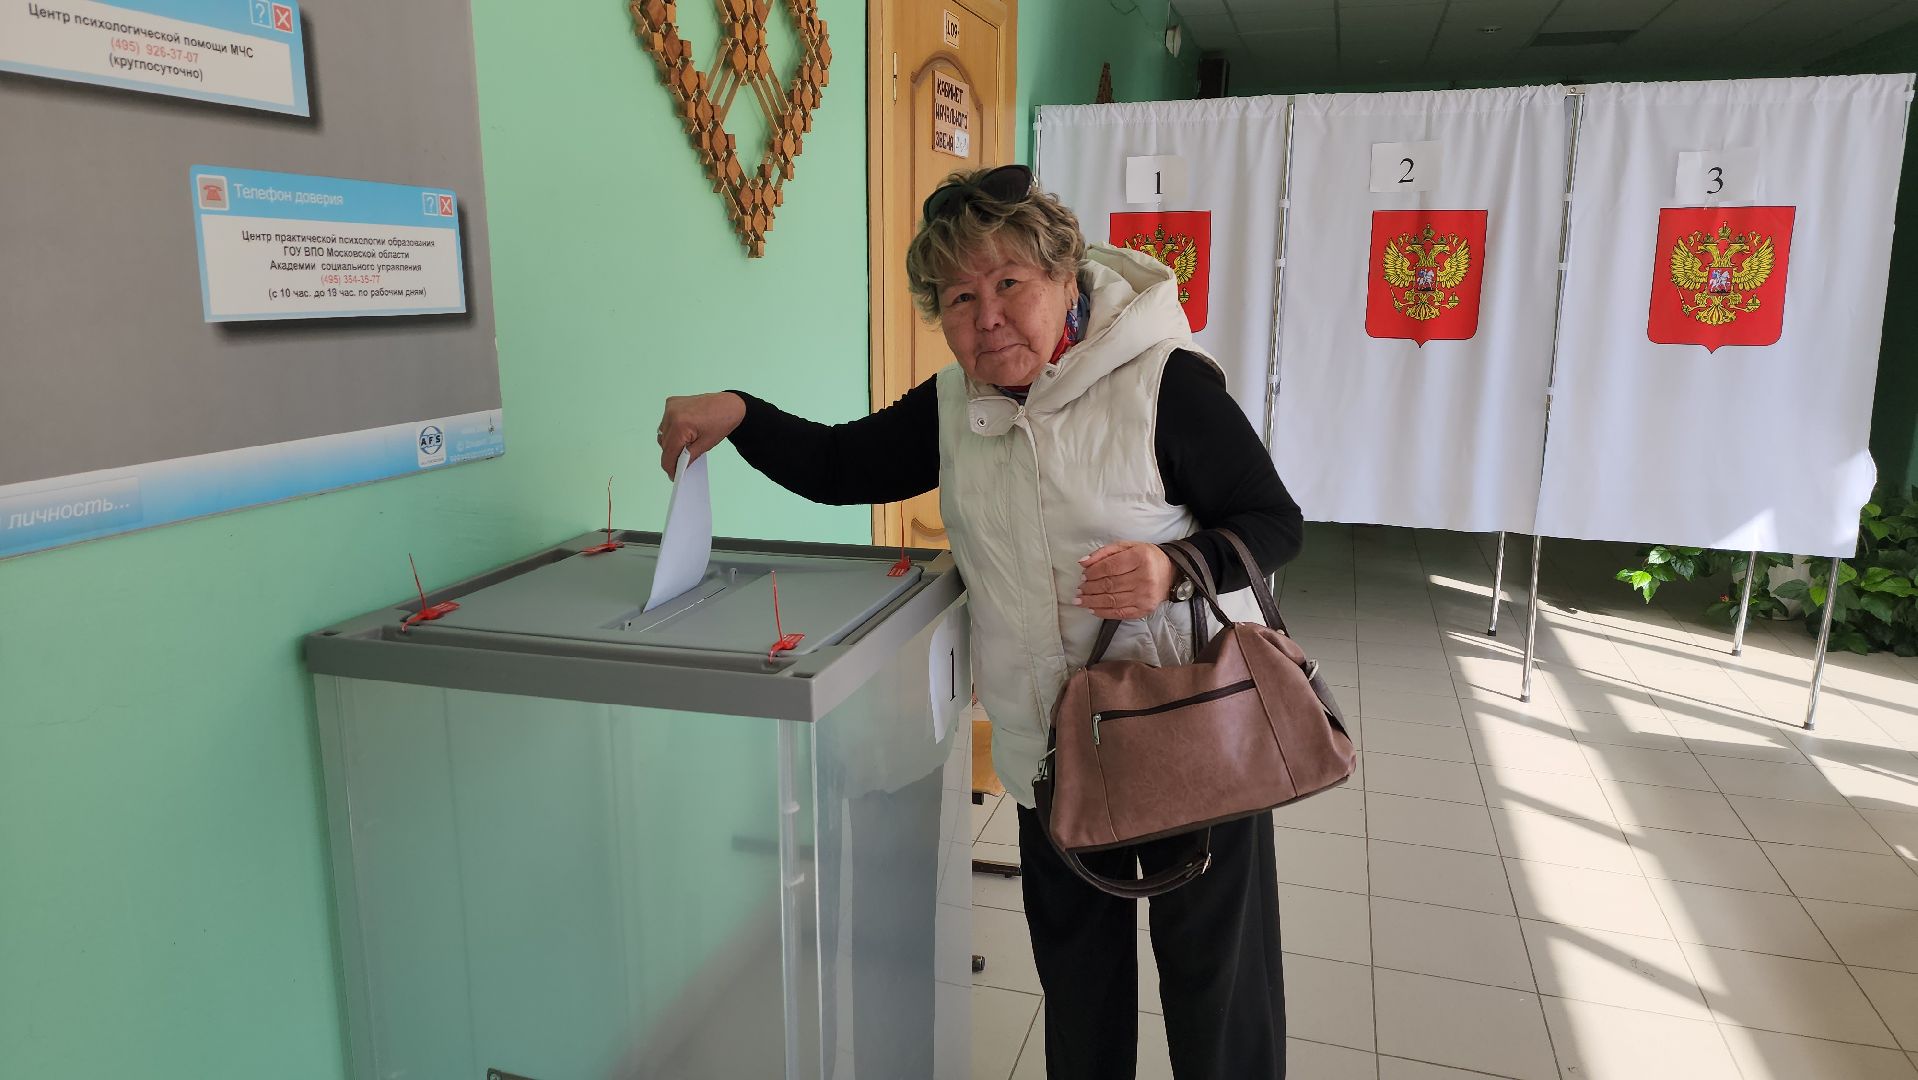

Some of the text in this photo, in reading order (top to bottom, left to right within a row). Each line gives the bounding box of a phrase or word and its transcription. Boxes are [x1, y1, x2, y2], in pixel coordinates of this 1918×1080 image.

[28, 2, 254, 58] Центр психологической помощи МЧС
[110, 37, 140, 56] (495)
[109, 52, 203, 82] (круглосуточно)
[936, 78, 964, 105] КАБИНЕТ
[935, 131, 954, 151] ЗВЕНА
[1153, 170, 1164, 195] 1
[1398, 158, 1415, 184] 2
[1707, 166, 1724, 195] 3
[233, 183, 344, 207] Телефон доверия
[242, 230, 435, 247] Центр практической психологии образования
[283, 246, 410, 259] ГОУ ВПО Московской области
[270, 260, 422, 273] Академии социального управления
[320, 275, 341, 286] (495)
[268, 288, 278, 300] (с
[280, 288, 291, 298] 10
[292, 290, 312, 298] час.
[313, 290, 325, 299] до
[358, 289, 368, 297] по
[370, 287, 404, 298] рабочим
[405, 287, 427, 298] дням)
[420, 434, 441, 447] AFS
[7, 499, 130, 530] личность...
[949, 647, 956, 702] 1
